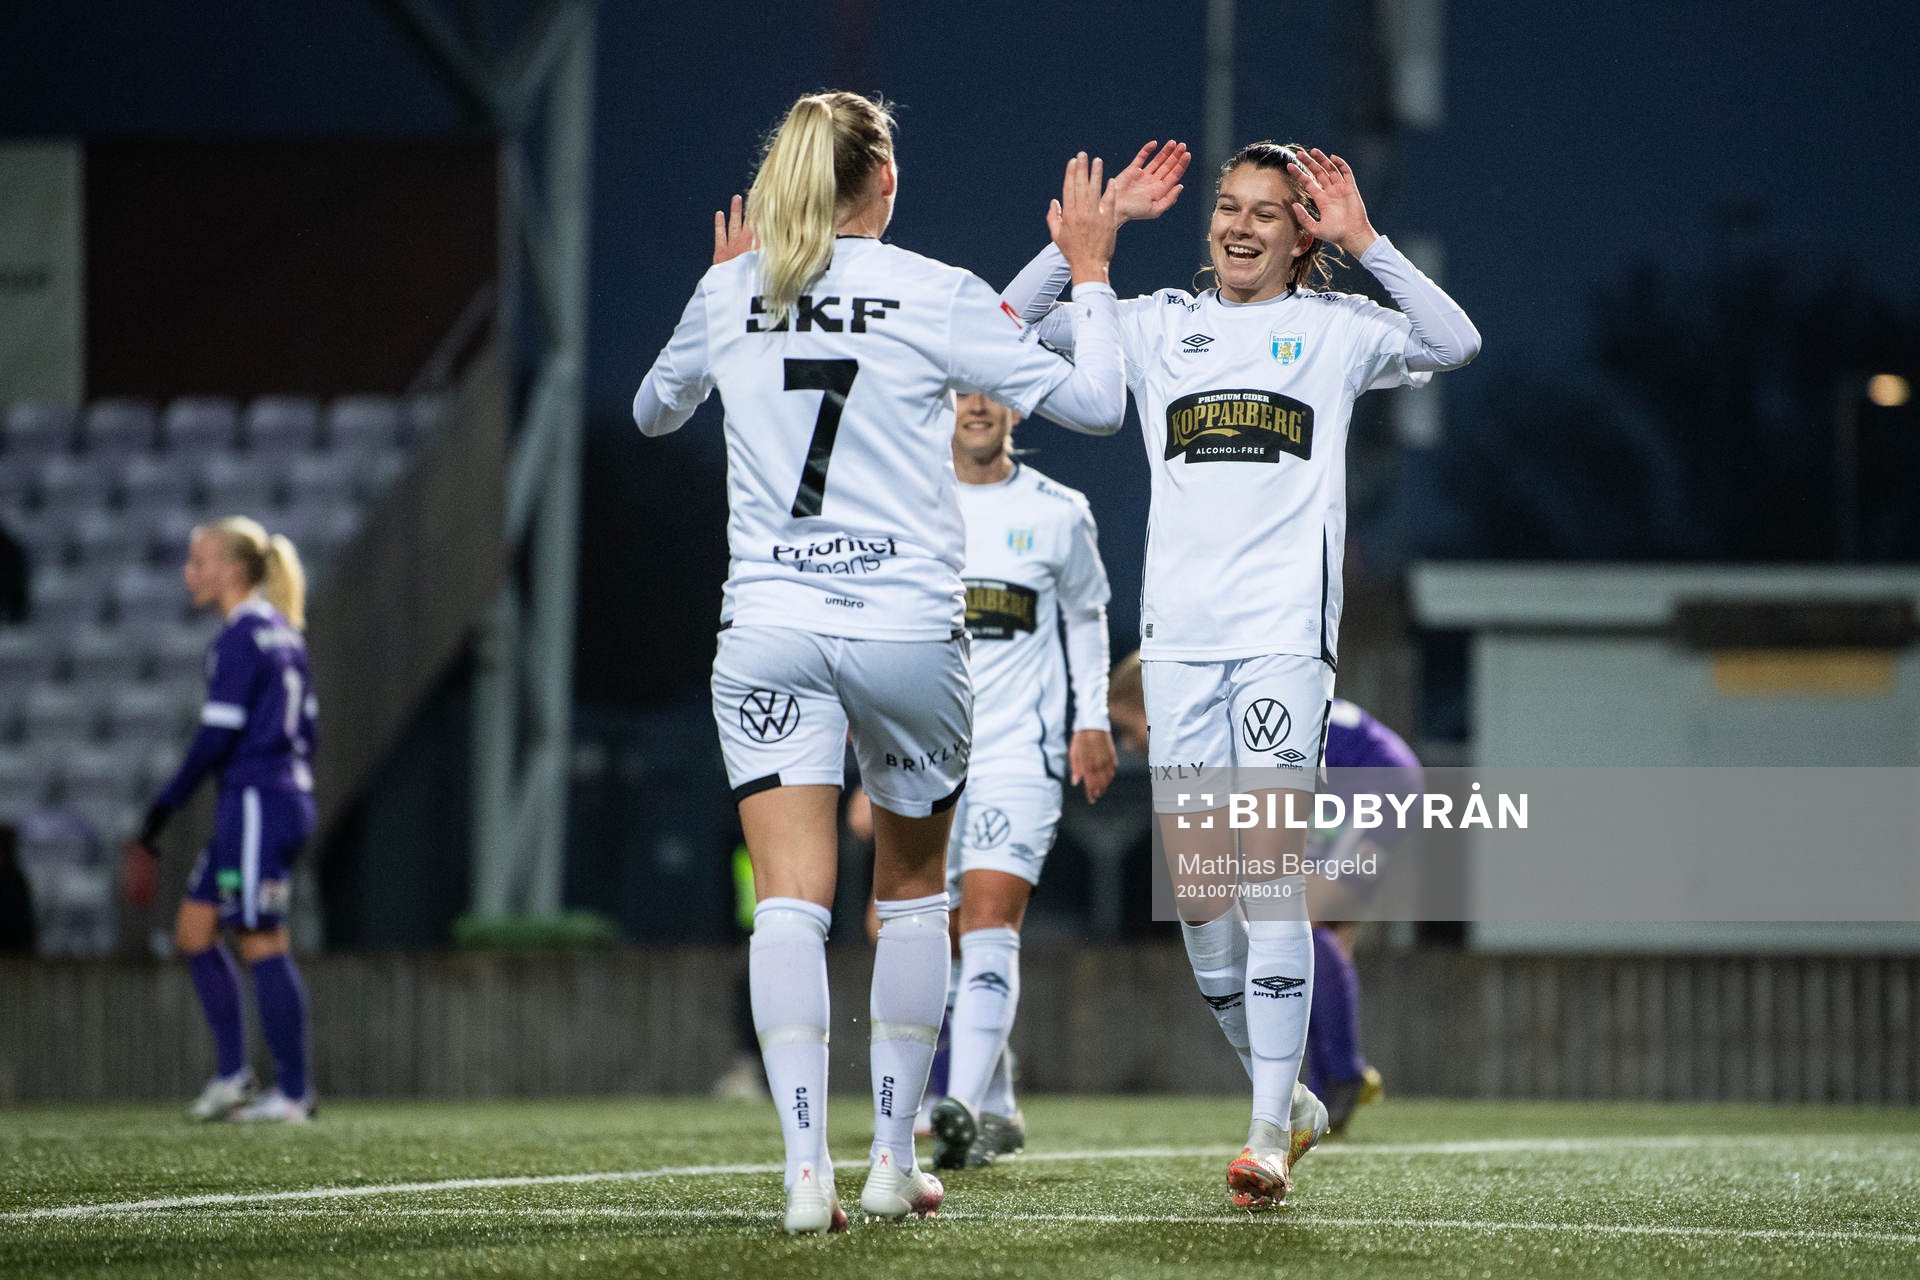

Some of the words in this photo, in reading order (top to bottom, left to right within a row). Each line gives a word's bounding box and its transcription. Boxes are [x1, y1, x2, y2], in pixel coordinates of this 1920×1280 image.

[746, 295, 900, 333] SKF
[1198, 393, 1241, 404] PREMIUM
[1242, 392, 1270, 404] CIDER
[783, 357, 860, 519] 7
[1171, 401, 1302, 446] KOPPARBERG
[1196, 446, 1265, 455] ALCOHOL-FREE
[825, 597, 864, 609] umbro
[886, 740, 962, 772] BRIXLY
[1150, 761, 1204, 781] IXLY
[1276, 762, 1303, 772] umbro
[793, 1086, 810, 1130] umbro
[880, 1075, 895, 1118] umbro
